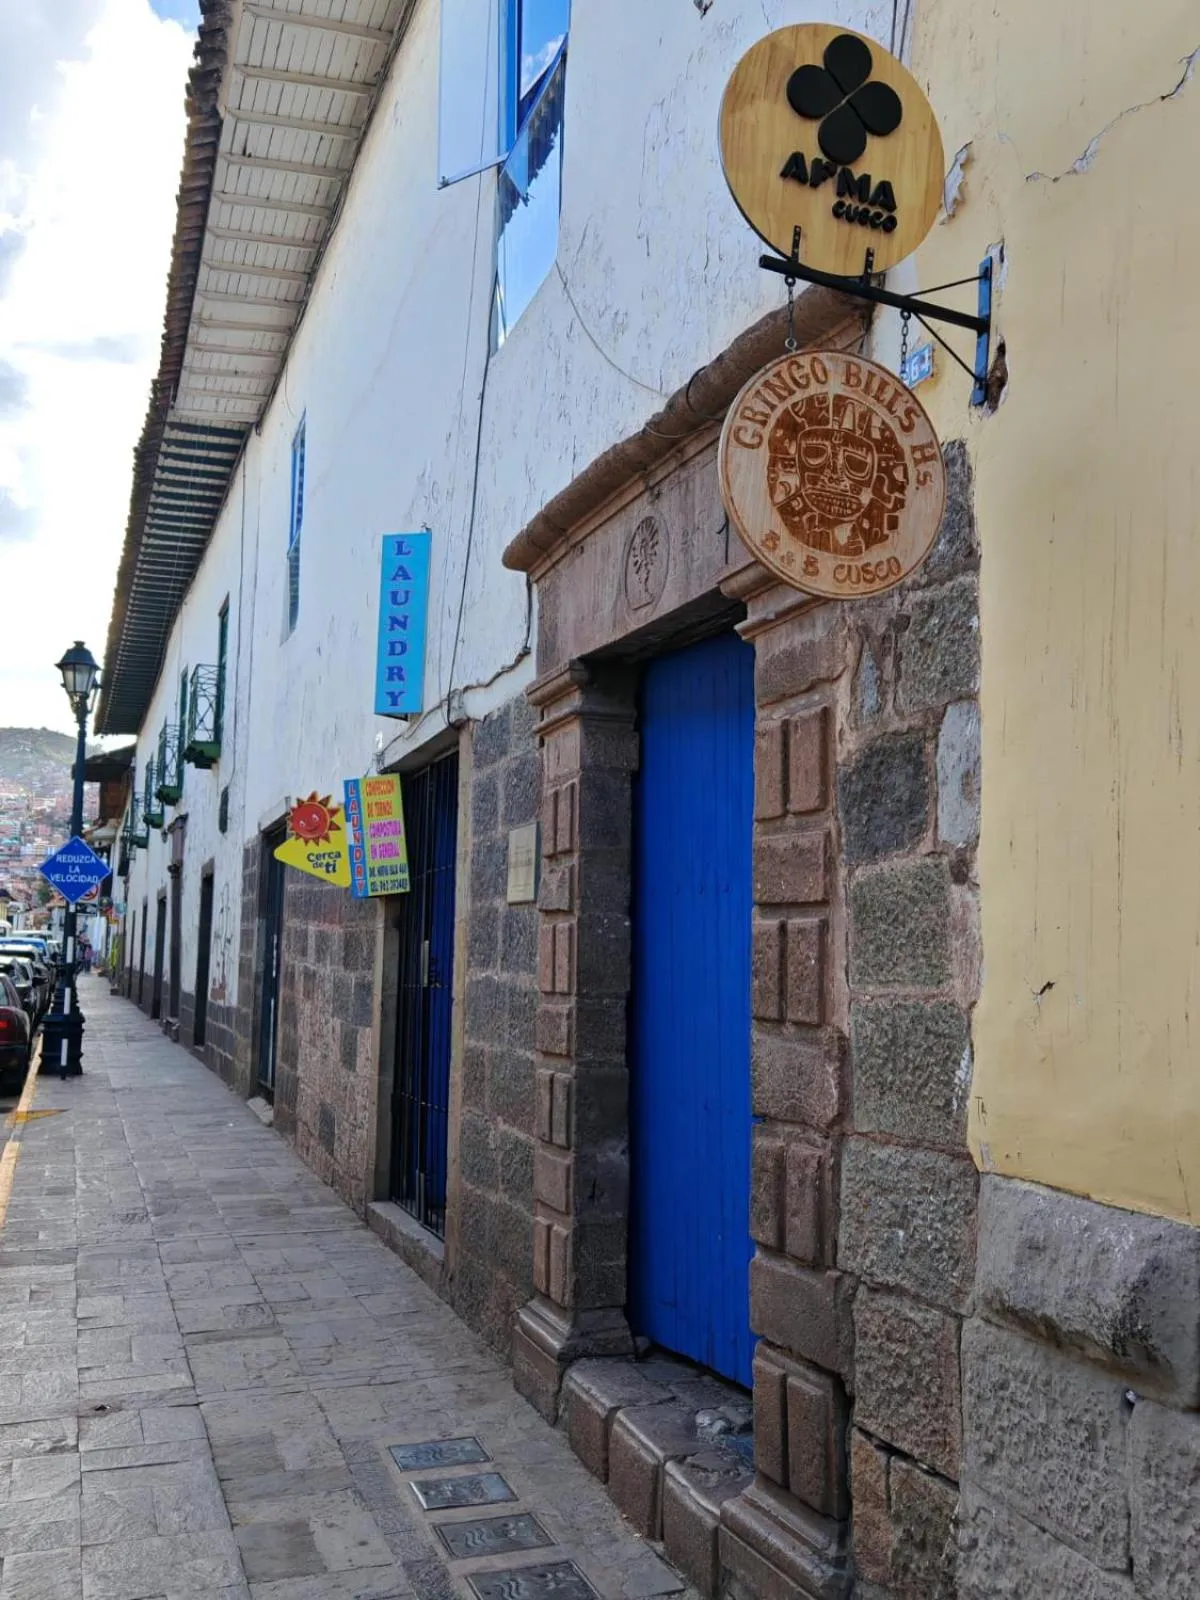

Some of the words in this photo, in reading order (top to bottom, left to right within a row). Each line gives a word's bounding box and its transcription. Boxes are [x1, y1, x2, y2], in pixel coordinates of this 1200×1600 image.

[733, 356, 828, 449] GRINGO
[841, 360, 920, 433] BILL'S
[803, 555, 820, 577] B
[833, 556, 902, 585] CUSCO
[385, 540, 412, 707] LAUNDRY
[349, 783, 366, 892] LAUNDRY
[56, 853, 97, 864] REDUZCA
[312, 861, 325, 869] de
[50, 873, 98, 884] VELOCIDAD
[68, 864, 80, 874] LA
